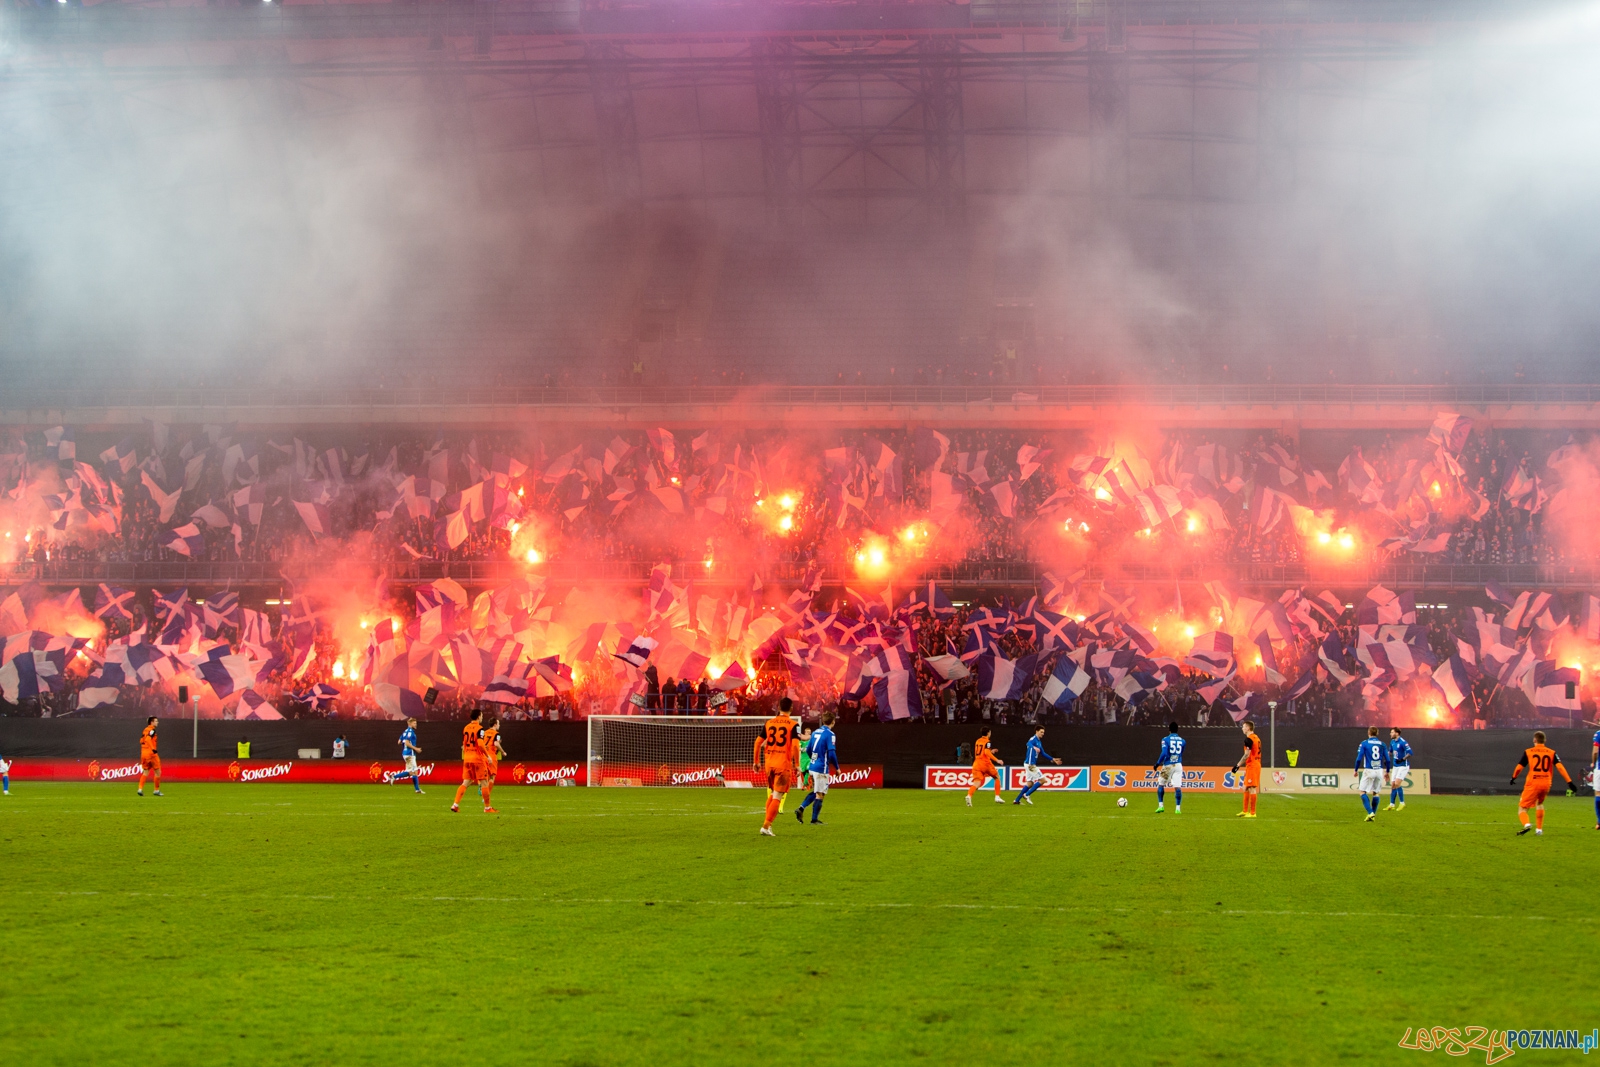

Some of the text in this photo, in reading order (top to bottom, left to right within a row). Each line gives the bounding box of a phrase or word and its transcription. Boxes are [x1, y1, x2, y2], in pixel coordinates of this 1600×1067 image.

[464, 731, 476, 747] 24
[485, 736, 492, 746] 7
[767, 726, 787, 747] 33
[812, 734, 821, 751] 7
[976, 744, 983, 756] 17
[1169, 740, 1183, 755] 55
[1371, 745, 1380, 760] 8
[241, 761, 292, 782] SOKOŁÓW
[1532, 754, 1551, 773] 20
[382, 762, 435, 783] SOÓW
[526, 763, 579, 784] SOKOŁÓW
[828, 766, 872, 785] OKOŁÓW
[1016, 770, 1064, 786] tsa
[1098, 769, 1127, 788] STS
[1145, 770, 1205, 780] ZAADY
[1304, 775, 1336, 786] LECH
[1132, 781, 1215, 789] BUKMCERSKIE
